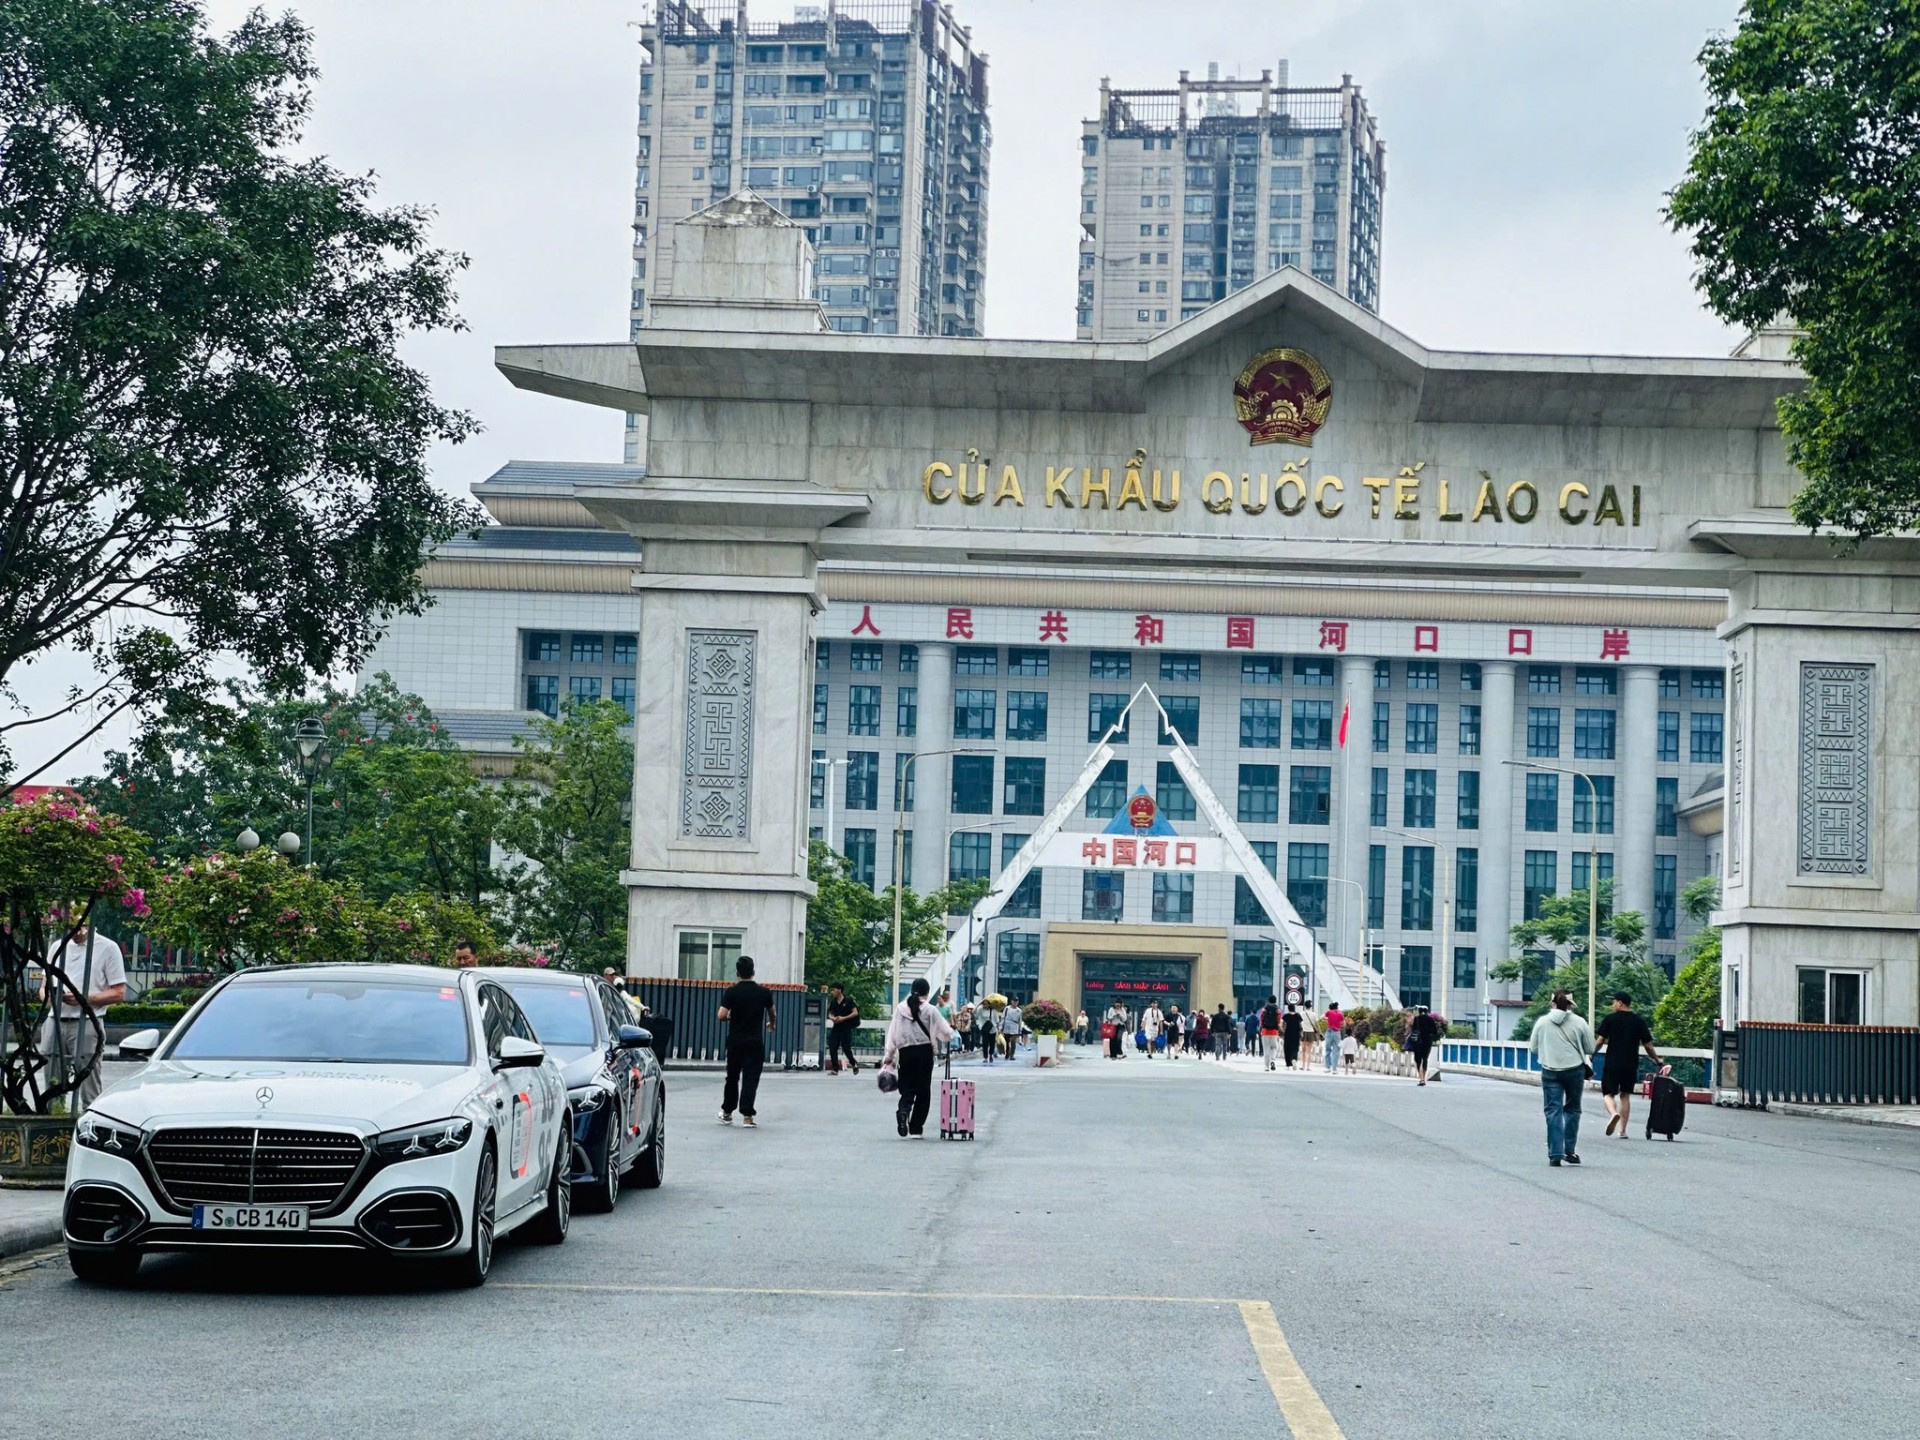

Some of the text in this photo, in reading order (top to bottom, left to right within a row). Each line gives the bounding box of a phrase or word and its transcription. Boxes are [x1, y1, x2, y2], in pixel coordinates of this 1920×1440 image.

[923, 447, 1641, 527] CỬA KHẨU QUỐC TẾ LÀO CAI
[851, 605, 1631, 661] 人民共和国河口口岸
[1082, 837, 1196, 866] 中国河口
[211, 1208, 300, 1228] S CB 140
